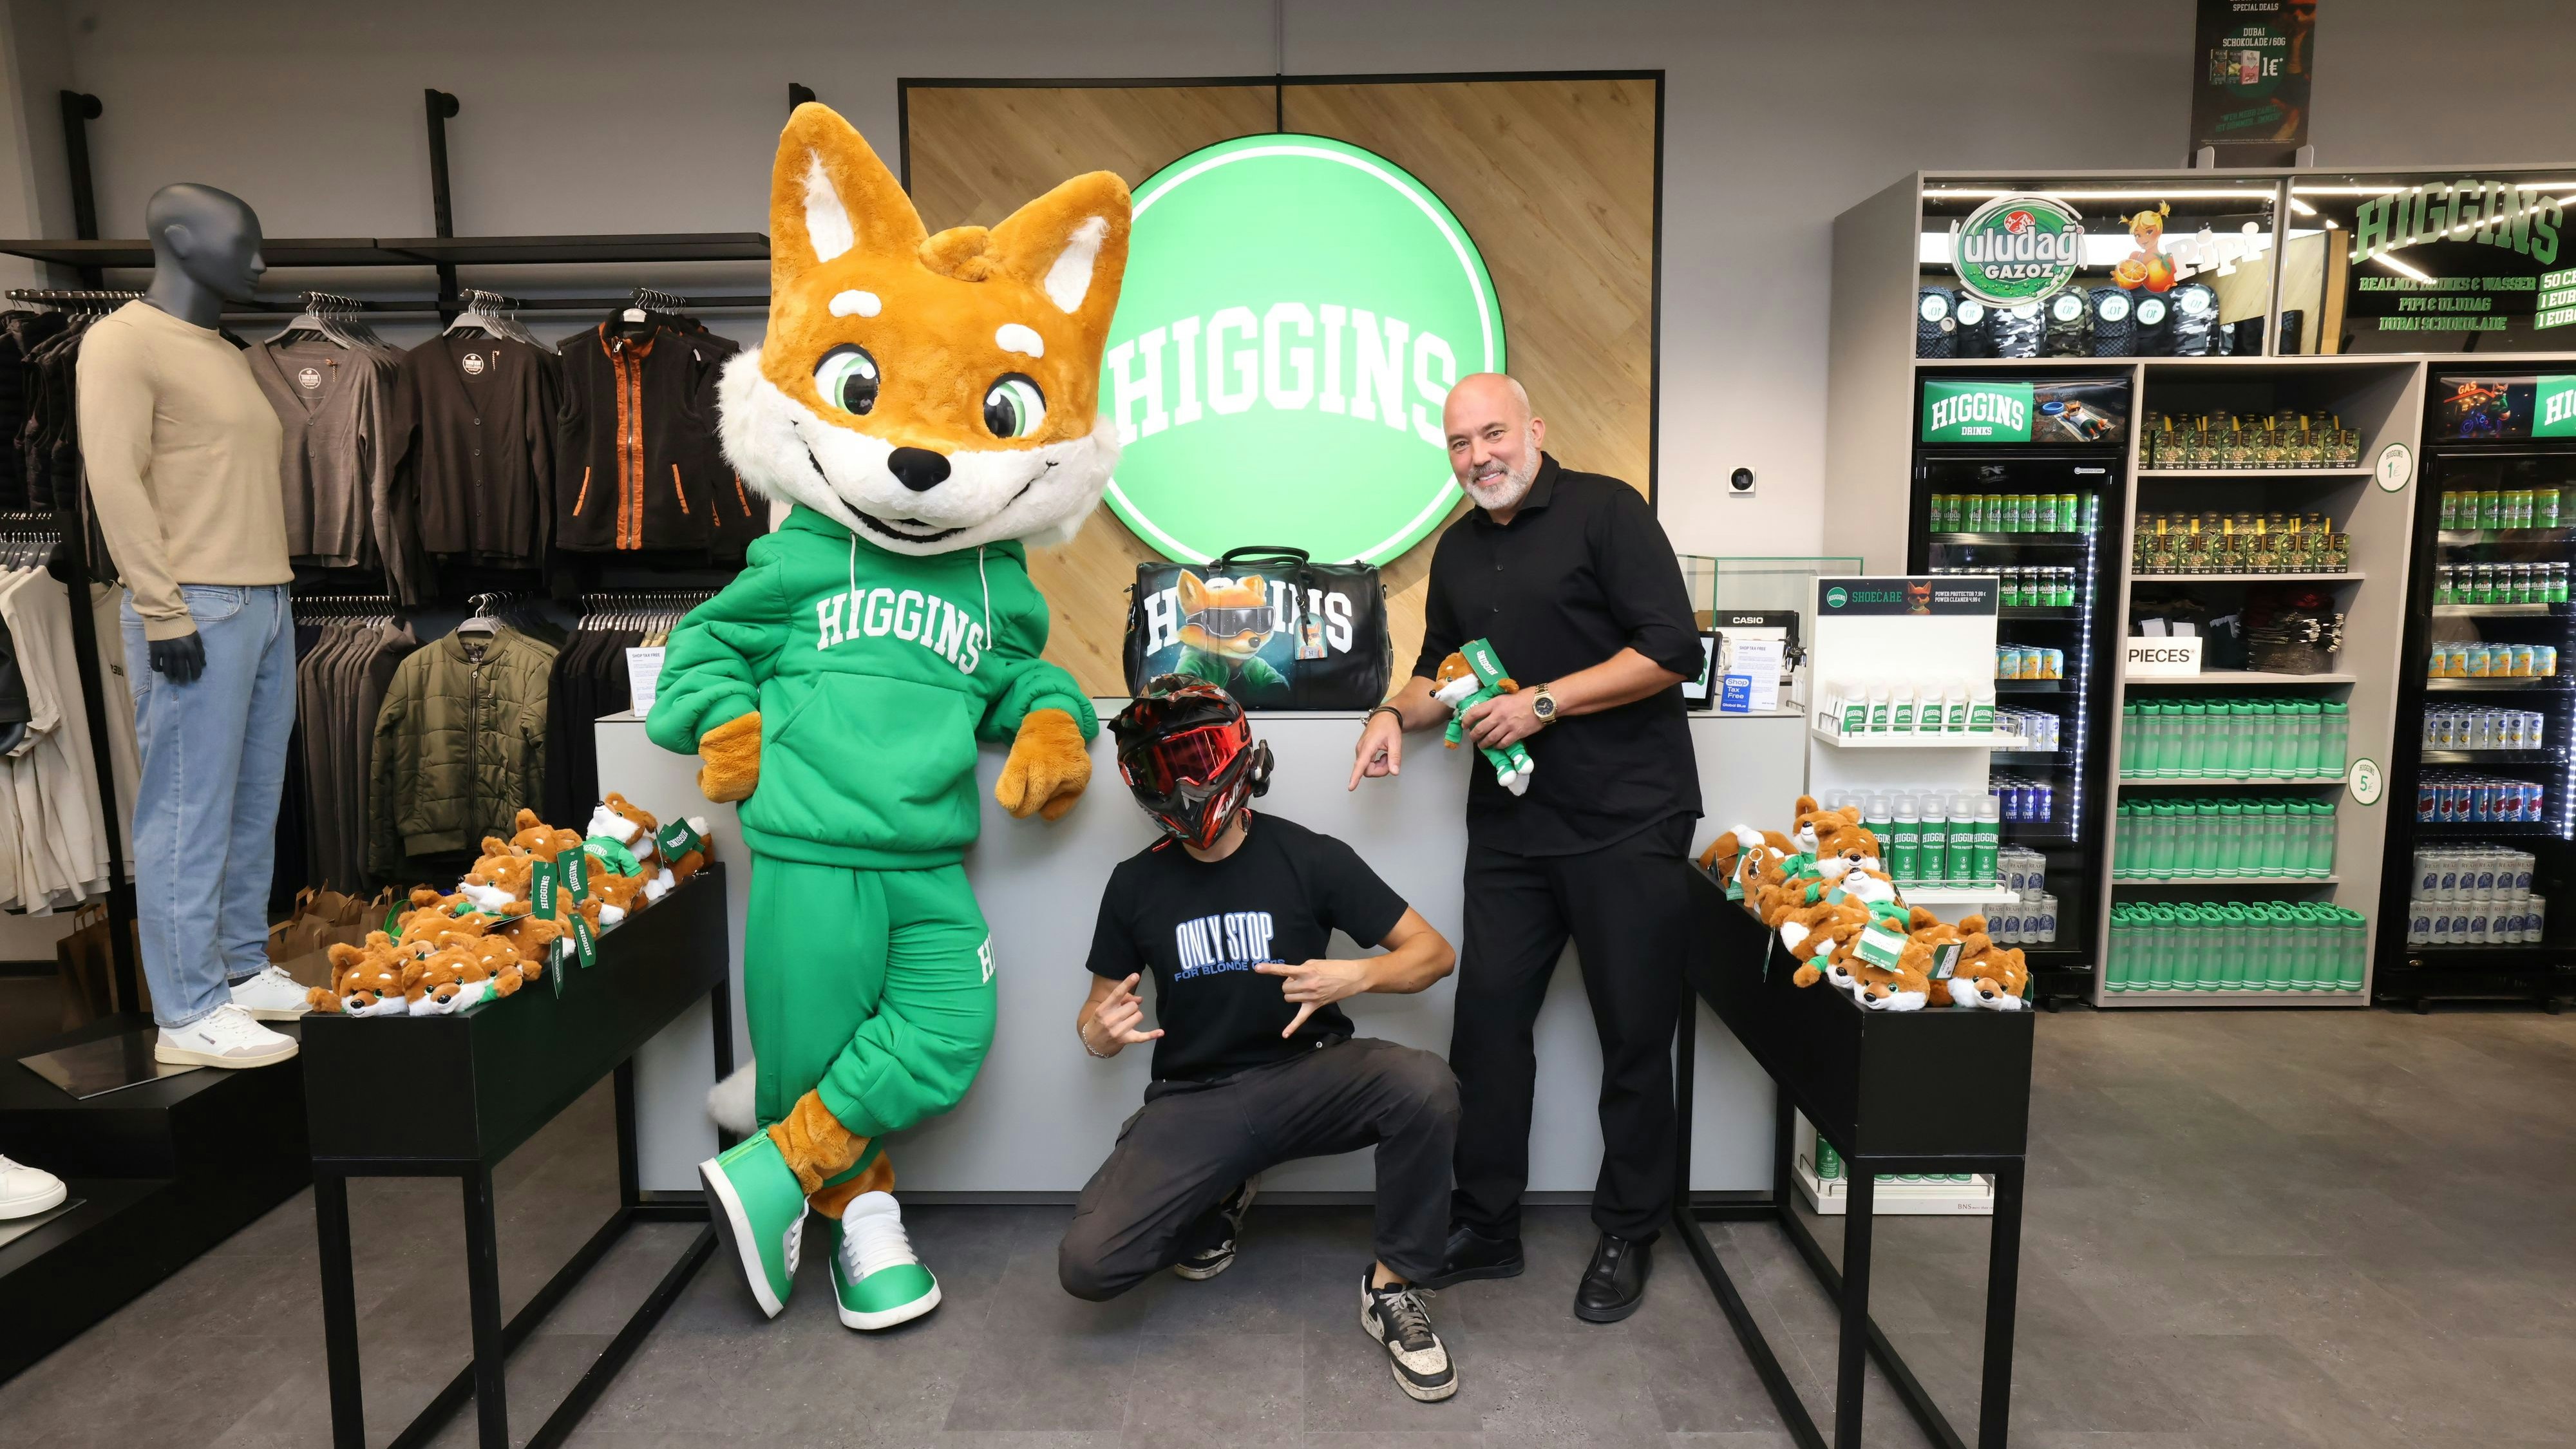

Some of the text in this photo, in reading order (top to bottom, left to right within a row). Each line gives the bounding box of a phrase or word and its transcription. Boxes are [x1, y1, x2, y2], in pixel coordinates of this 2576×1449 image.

[2243, 28, 2265, 37] DUBAI
[2222, 38, 2268, 47] SCHOKOLADE
[2273, 37, 2286, 46] 60G
[2352, 180, 2563, 265] HIGGINS
[2164, 222, 2264, 281] Pipi
[1984, 263, 2054, 279] GAZOZ
[2359, 278, 2419, 290] REALMIX
[2482, 277, 2536, 290] WASSER
[2543, 273, 2561, 289] 50
[2399, 298, 2427, 311] PIPI
[2438, 298, 2492, 311] ULUDAG
[2379, 317, 2508, 330] DUBAI SCHOKOLADE
[2546, 308, 2576, 326] EUR
[1107, 302, 1457, 450] HIGGINS
[2458, 381, 2477, 395] GAS
[1931, 392, 2024, 432] HIGGINS
[1961, 426, 1993, 437] DRINKS
[1852, 591, 1902, 602] SHOECARE
[816, 588, 984, 674] HIGGINS
[1476, 650, 1499, 676] HIGGINS
[2128, 649, 2190, 663] PIECES
[667, 828, 688, 848] HIGGINS
[1922, 833, 1945, 844] HIGGIN
[1951, 833, 1973, 844] HIGGIN
[569, 860, 582, 892] HIGGINS
[540, 875, 550, 909] HIGGINS
[578, 924, 592, 956] HIGGINS
[1176, 911, 1274, 972] ONLY STOP
[1174, 970, 1200, 982] FOR
[1202, 961, 1248, 976] BLONDE
